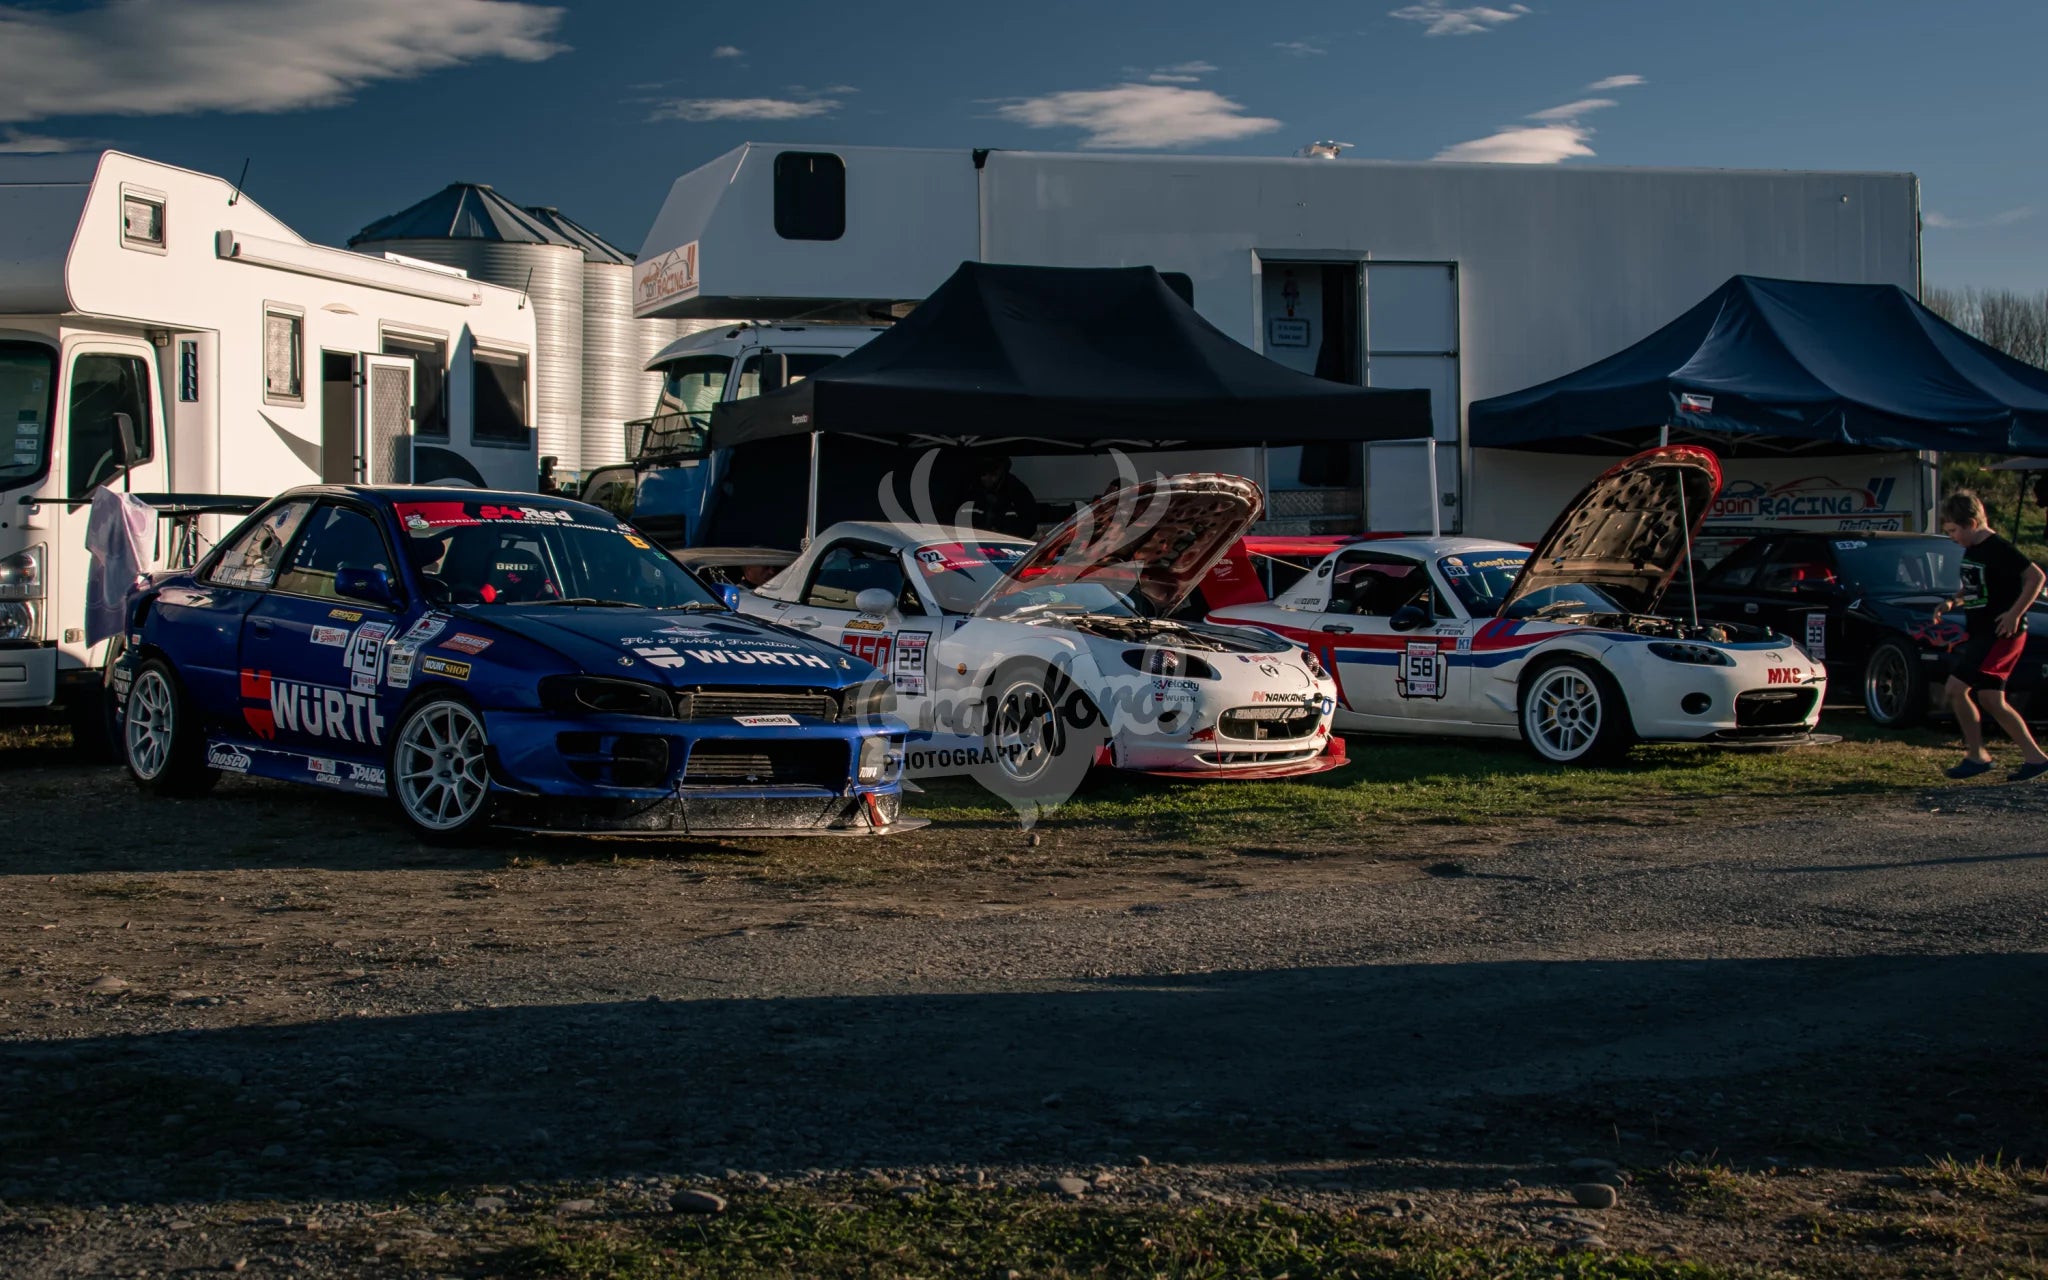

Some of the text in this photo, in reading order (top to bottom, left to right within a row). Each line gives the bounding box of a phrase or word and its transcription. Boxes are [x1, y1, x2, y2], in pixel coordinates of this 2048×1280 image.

[1758, 496, 1852, 515] RACING
[495, 518, 560, 527] MOTORSPORT
[1838, 519, 1900, 531] Haltech
[922, 551, 944, 563] 22
[1447, 566, 1466, 576] 58
[1808, 626, 1822, 643] 33
[667, 636, 726, 648] Funky
[725, 638, 801, 649] Furniture
[1457, 639, 1470, 650] K1
[357, 638, 379, 668] 43
[898, 648, 922, 670] 22
[425, 660, 468, 676] MOUNT SHOP
[1410, 657, 1433, 677] 58
[1160, 679, 1200, 692] Velocity
[1265, 692, 1307, 703] NANKANG
[211, 752, 248, 768] ROSCO
